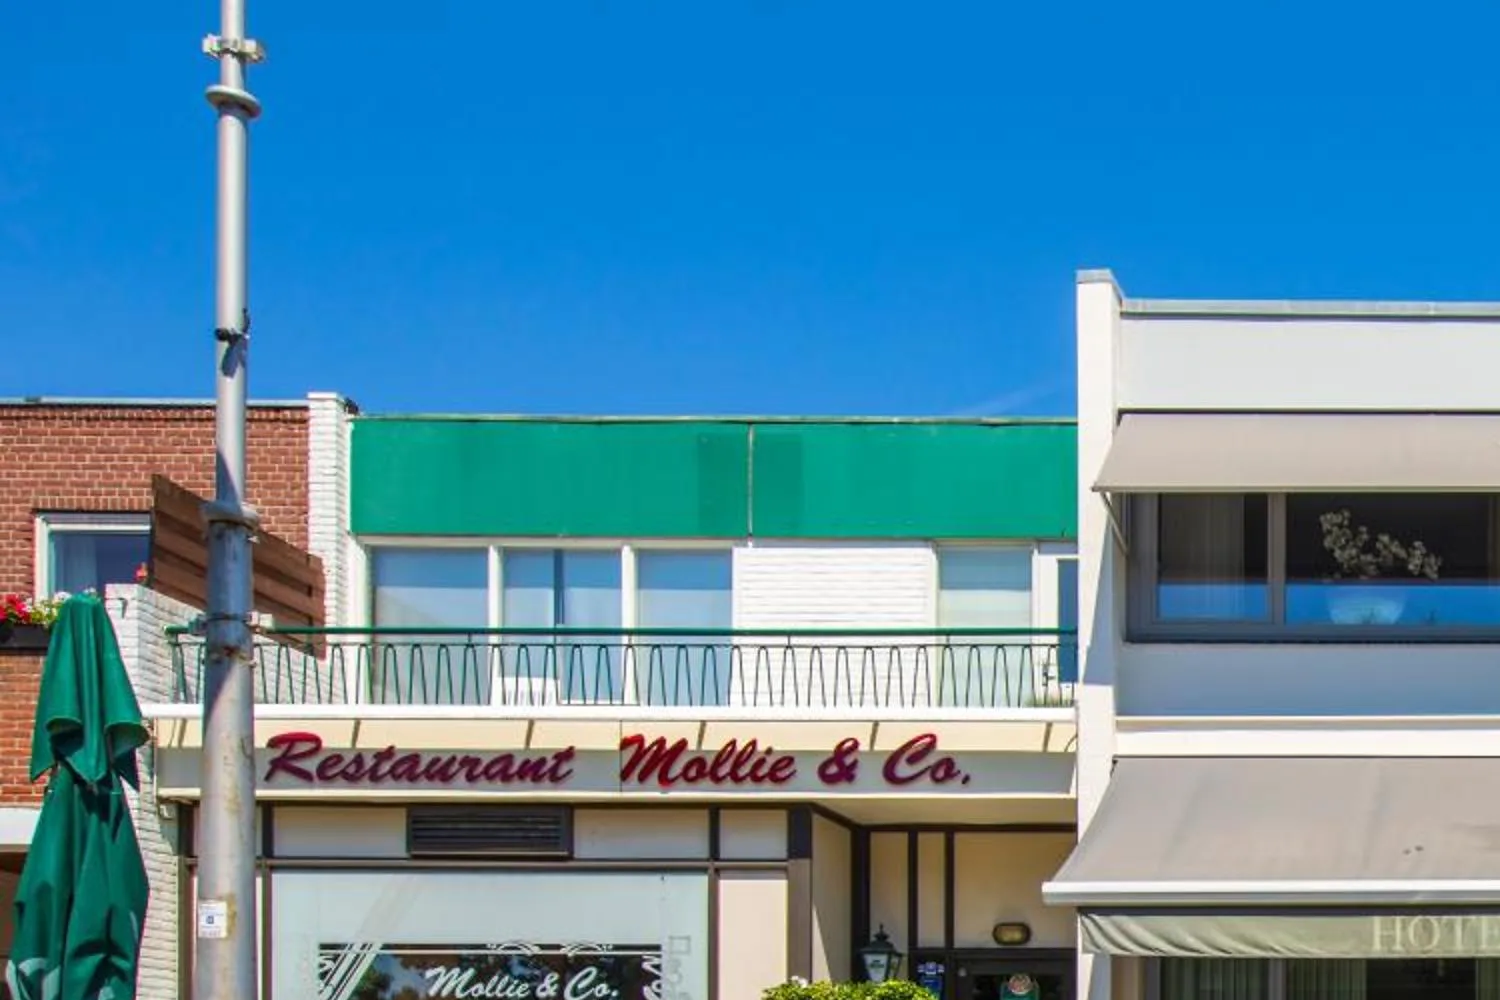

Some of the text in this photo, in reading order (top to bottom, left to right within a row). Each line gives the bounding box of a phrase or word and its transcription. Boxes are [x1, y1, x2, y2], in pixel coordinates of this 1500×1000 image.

[264, 731, 972, 786] Restaurant Mollie & Co.
[425, 965, 530, 999] Mollie
[535, 970, 558, 998] &
